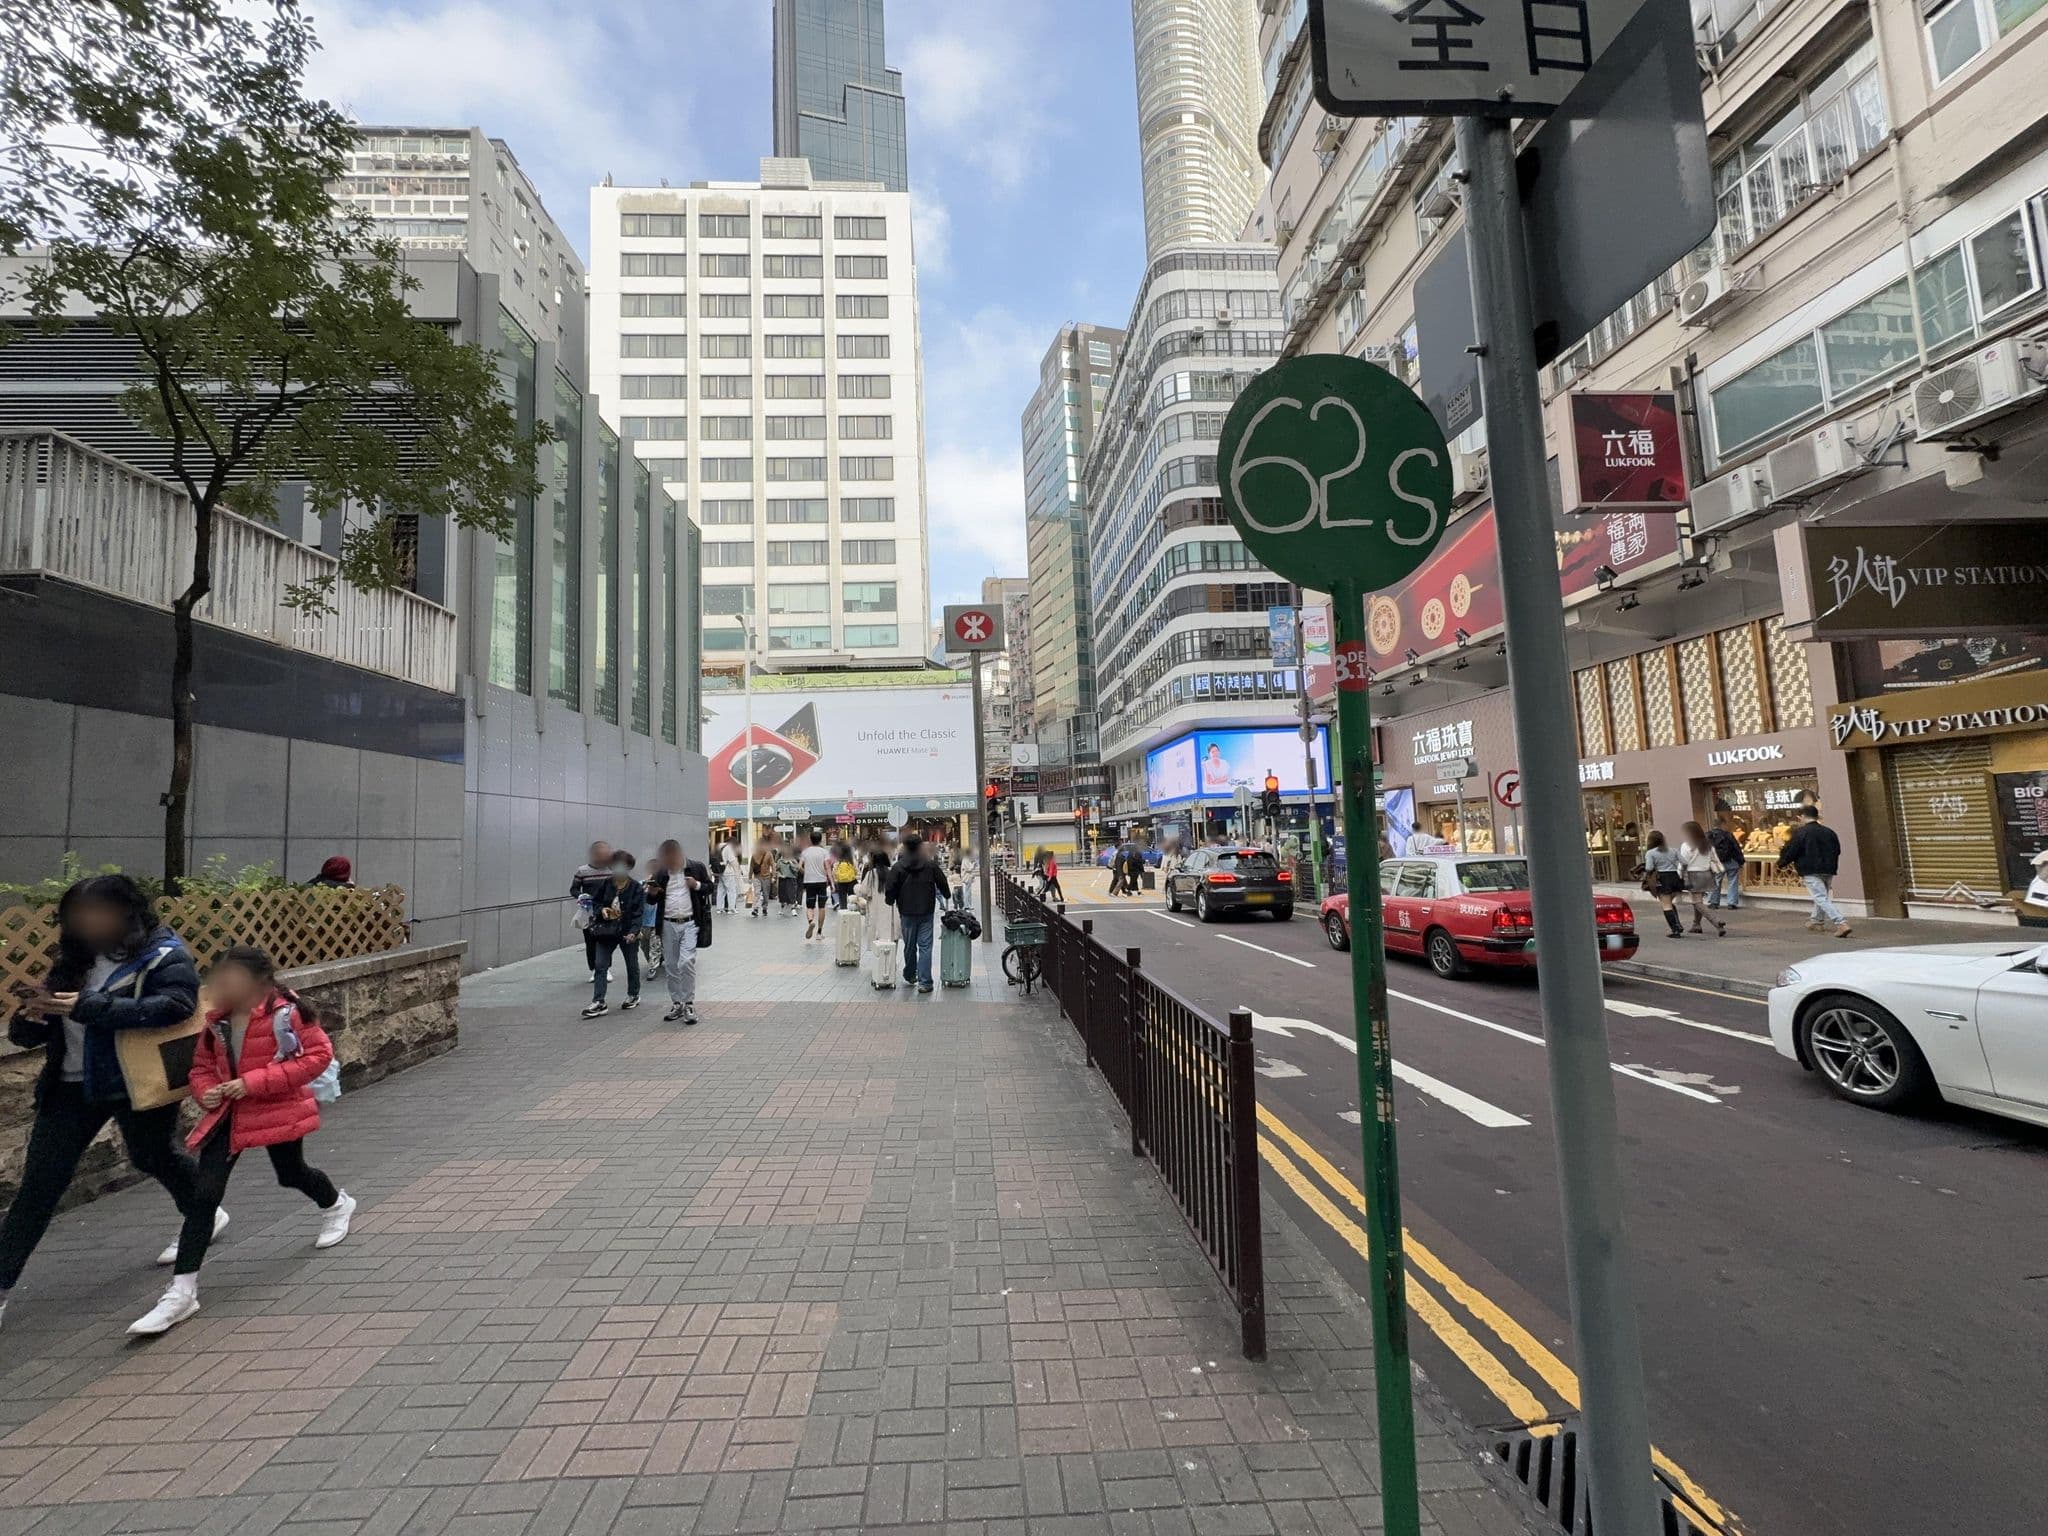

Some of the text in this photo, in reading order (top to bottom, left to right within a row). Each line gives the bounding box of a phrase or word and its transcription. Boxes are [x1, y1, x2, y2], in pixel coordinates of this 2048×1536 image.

[1391, 0, 1593, 76] 全日
[1602, 429, 1655, 457] 六福
[1605, 457, 1655, 467] LUKFOOK
[1907, 567, 1948, 586] VIP
[857, 728, 956, 741] Unfold the Classic
[1889, 718, 1931, 738] VIP
[1412, 720, 1473, 756] 六福珠寶
[1414, 753, 1440, 765] LUKFOOK
[1708, 744, 1784, 767] LUKFOOK
[2014, 787, 2044, 798] BIG
[863, 802, 894, 813] hama
[943, 799, 976, 810] shama
